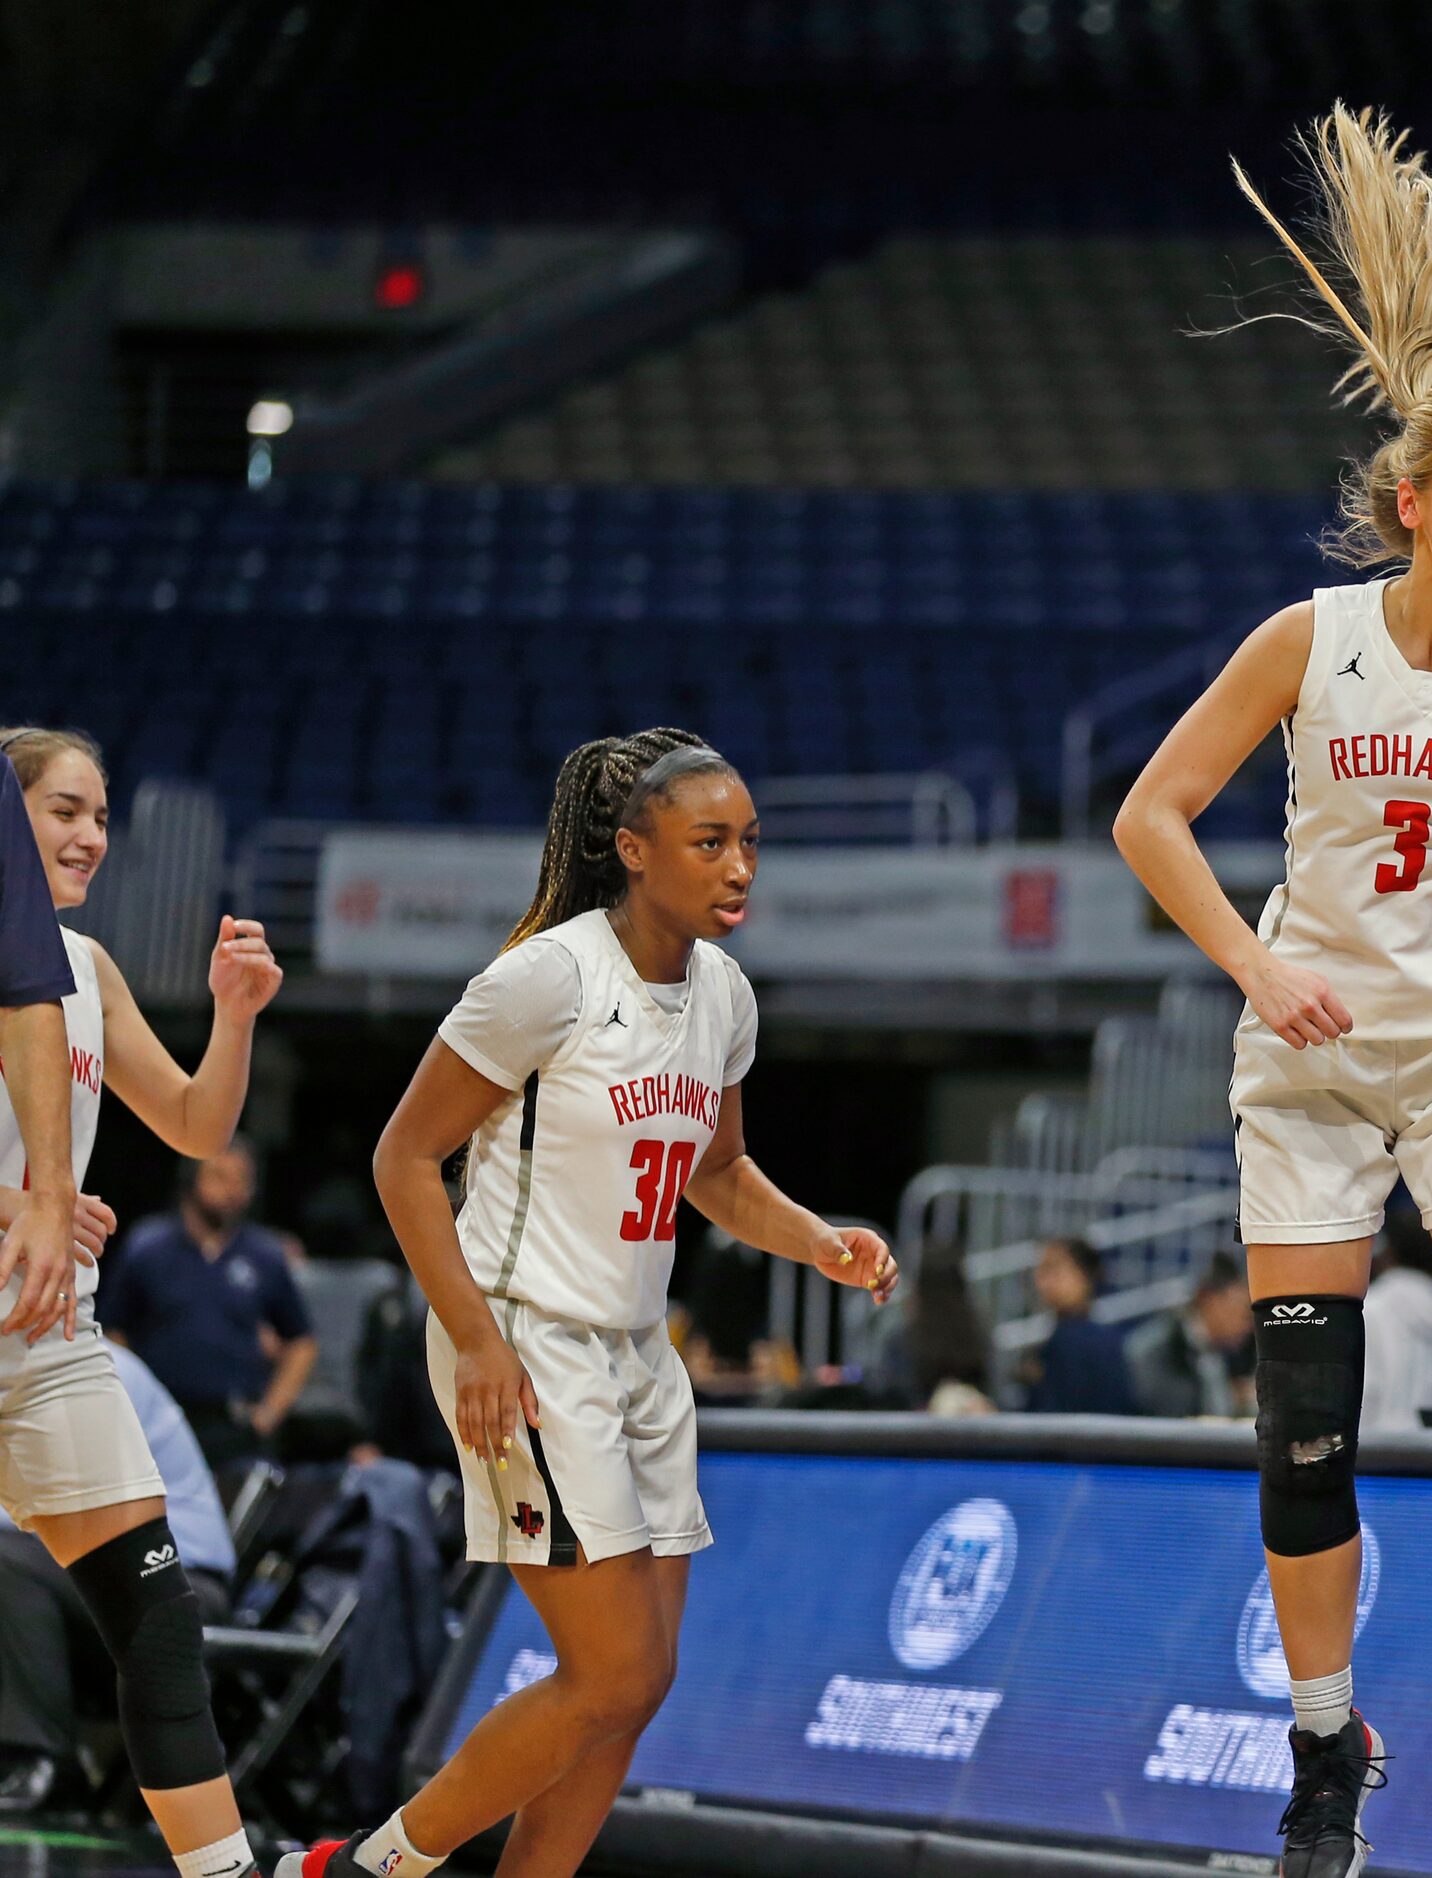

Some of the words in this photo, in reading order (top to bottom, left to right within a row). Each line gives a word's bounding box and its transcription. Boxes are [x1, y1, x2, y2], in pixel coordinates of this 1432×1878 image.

[1373, 799, 1432, 894] 3
[607, 1072, 720, 1132] REDHAWKS
[618, 1138, 697, 1242] 30
